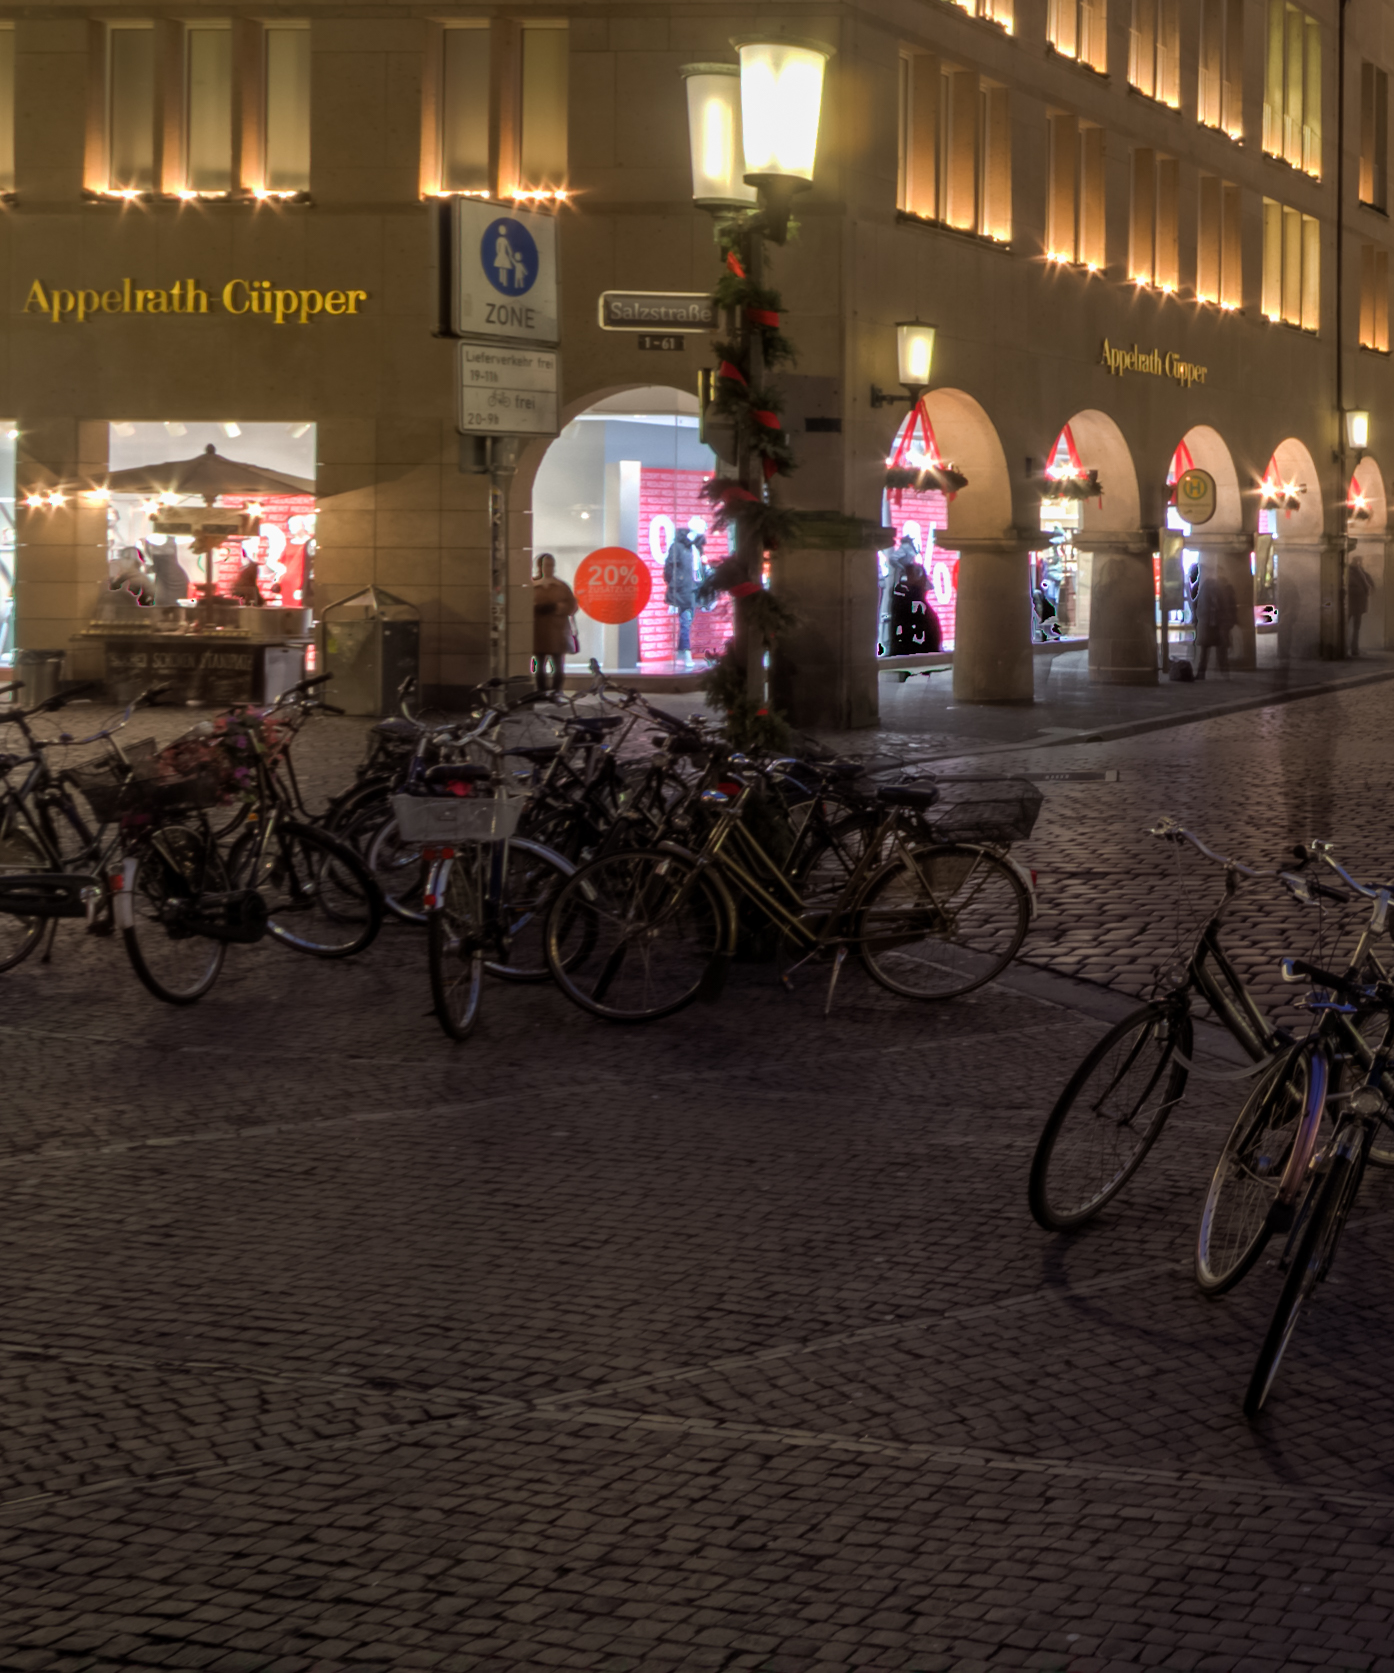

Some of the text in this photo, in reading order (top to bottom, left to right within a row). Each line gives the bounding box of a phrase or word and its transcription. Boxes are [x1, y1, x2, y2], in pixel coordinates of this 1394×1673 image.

[485, 302, 536, 329] ZONE
[610, 301, 712, 323] Salzstraße
[465, 350, 554, 370] Lieferverkehr frei
[515, 394, 536, 410] frei
[588, 565, 639, 586] 20%
